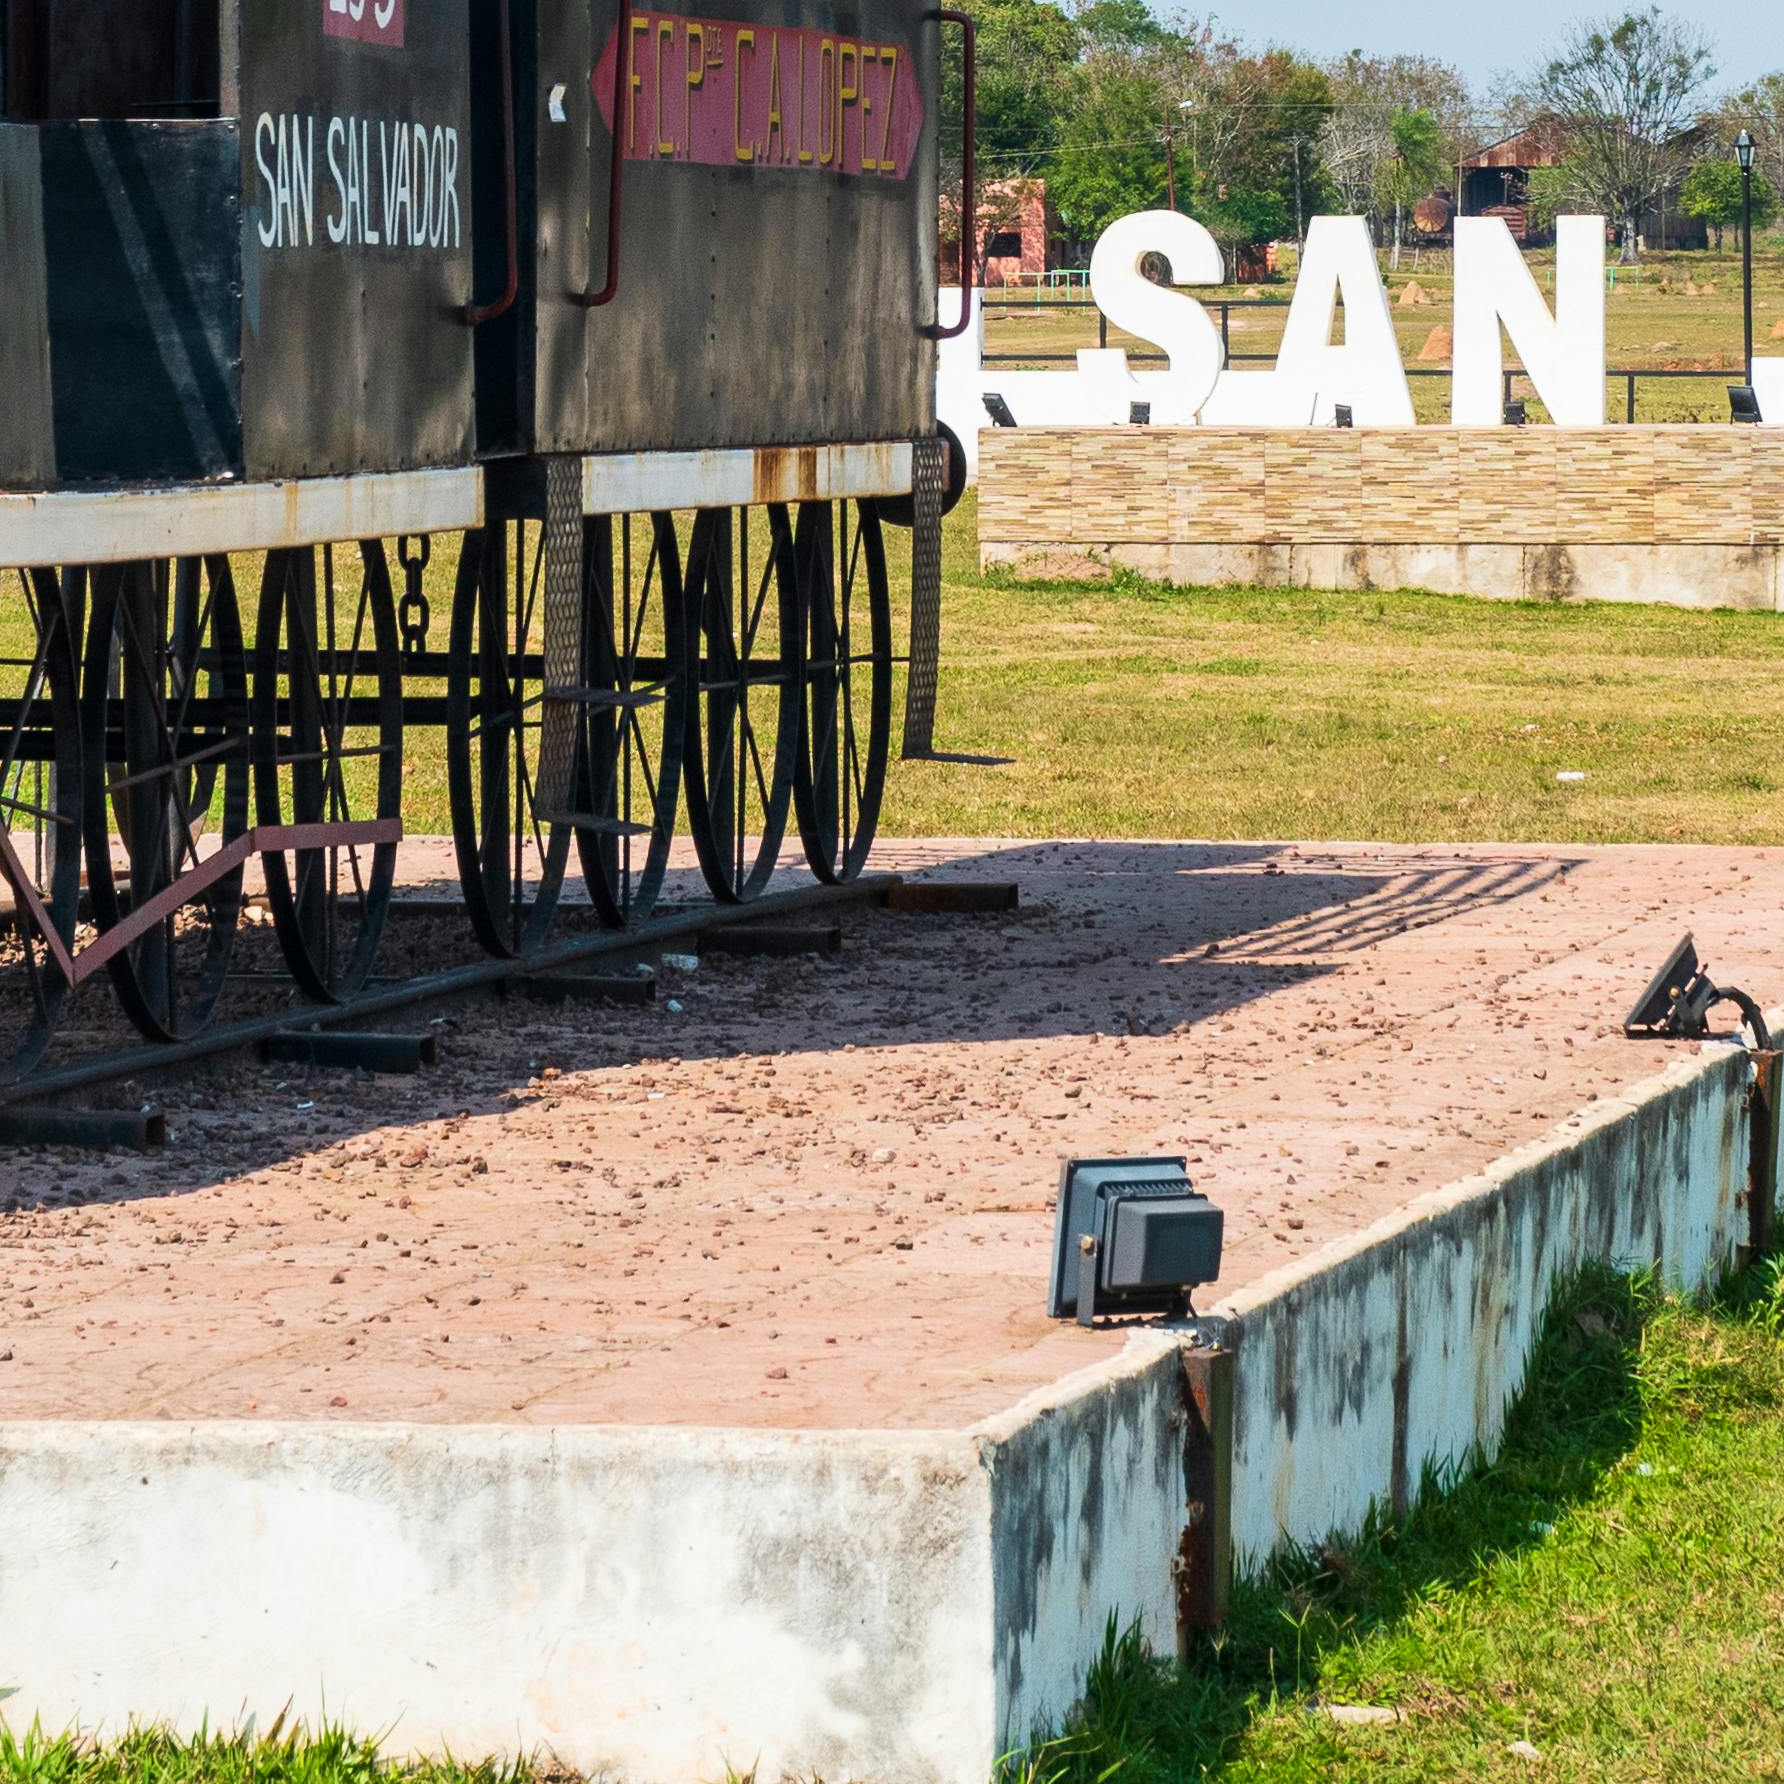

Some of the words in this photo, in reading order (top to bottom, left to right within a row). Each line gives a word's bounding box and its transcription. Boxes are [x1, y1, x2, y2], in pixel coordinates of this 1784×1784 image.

[255, 112, 313, 248] SAN
[327, 116, 460, 249] SALVADOR
[1089, 209, 1606, 427] SAN
